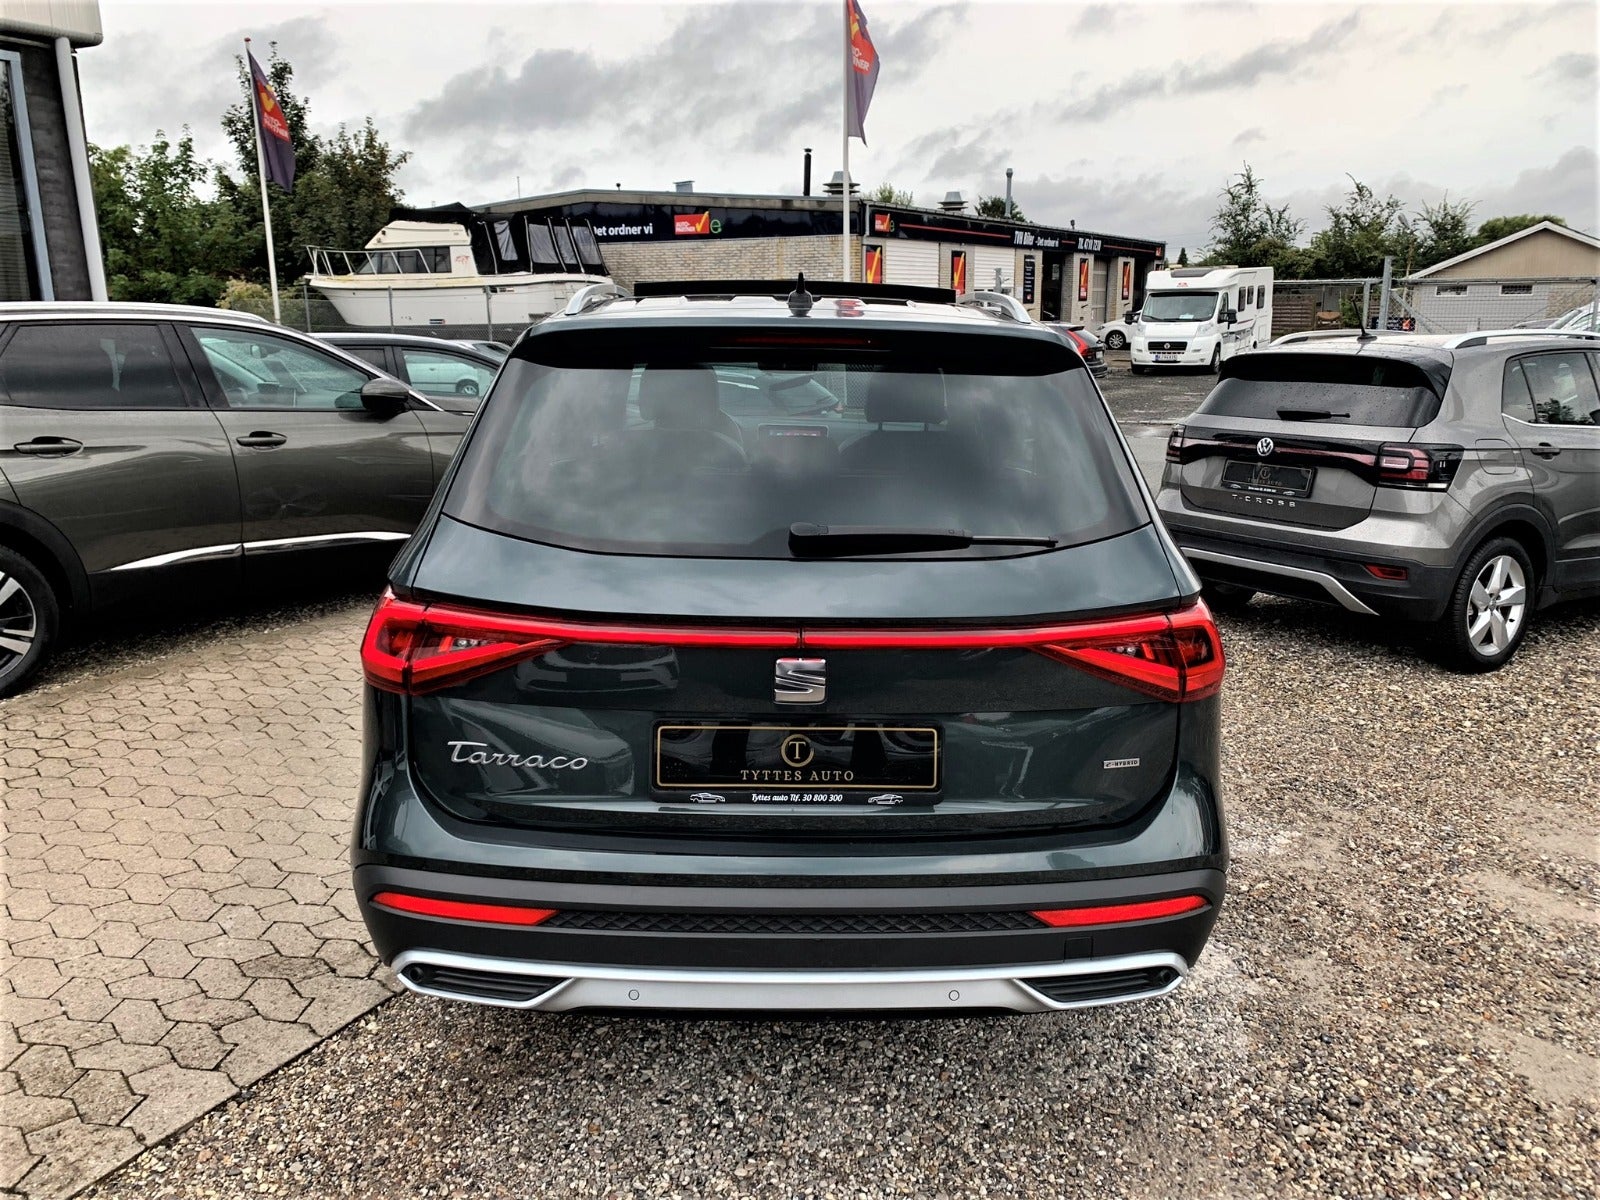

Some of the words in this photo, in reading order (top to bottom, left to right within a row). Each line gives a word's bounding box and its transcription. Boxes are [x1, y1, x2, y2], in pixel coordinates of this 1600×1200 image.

[608, 224, 642, 236] ordner
[643, 223, 653, 234] vi
[448, 741, 588, 770] Tarraco
[740, 770, 802, 781] TYTTES
[809, 770, 854, 781] AUTO
[752, 793, 771, 802] Tyttes
[802, 794, 812, 802] 30
[813, 794, 828, 802] 800
[828, 794, 843, 802] 300
